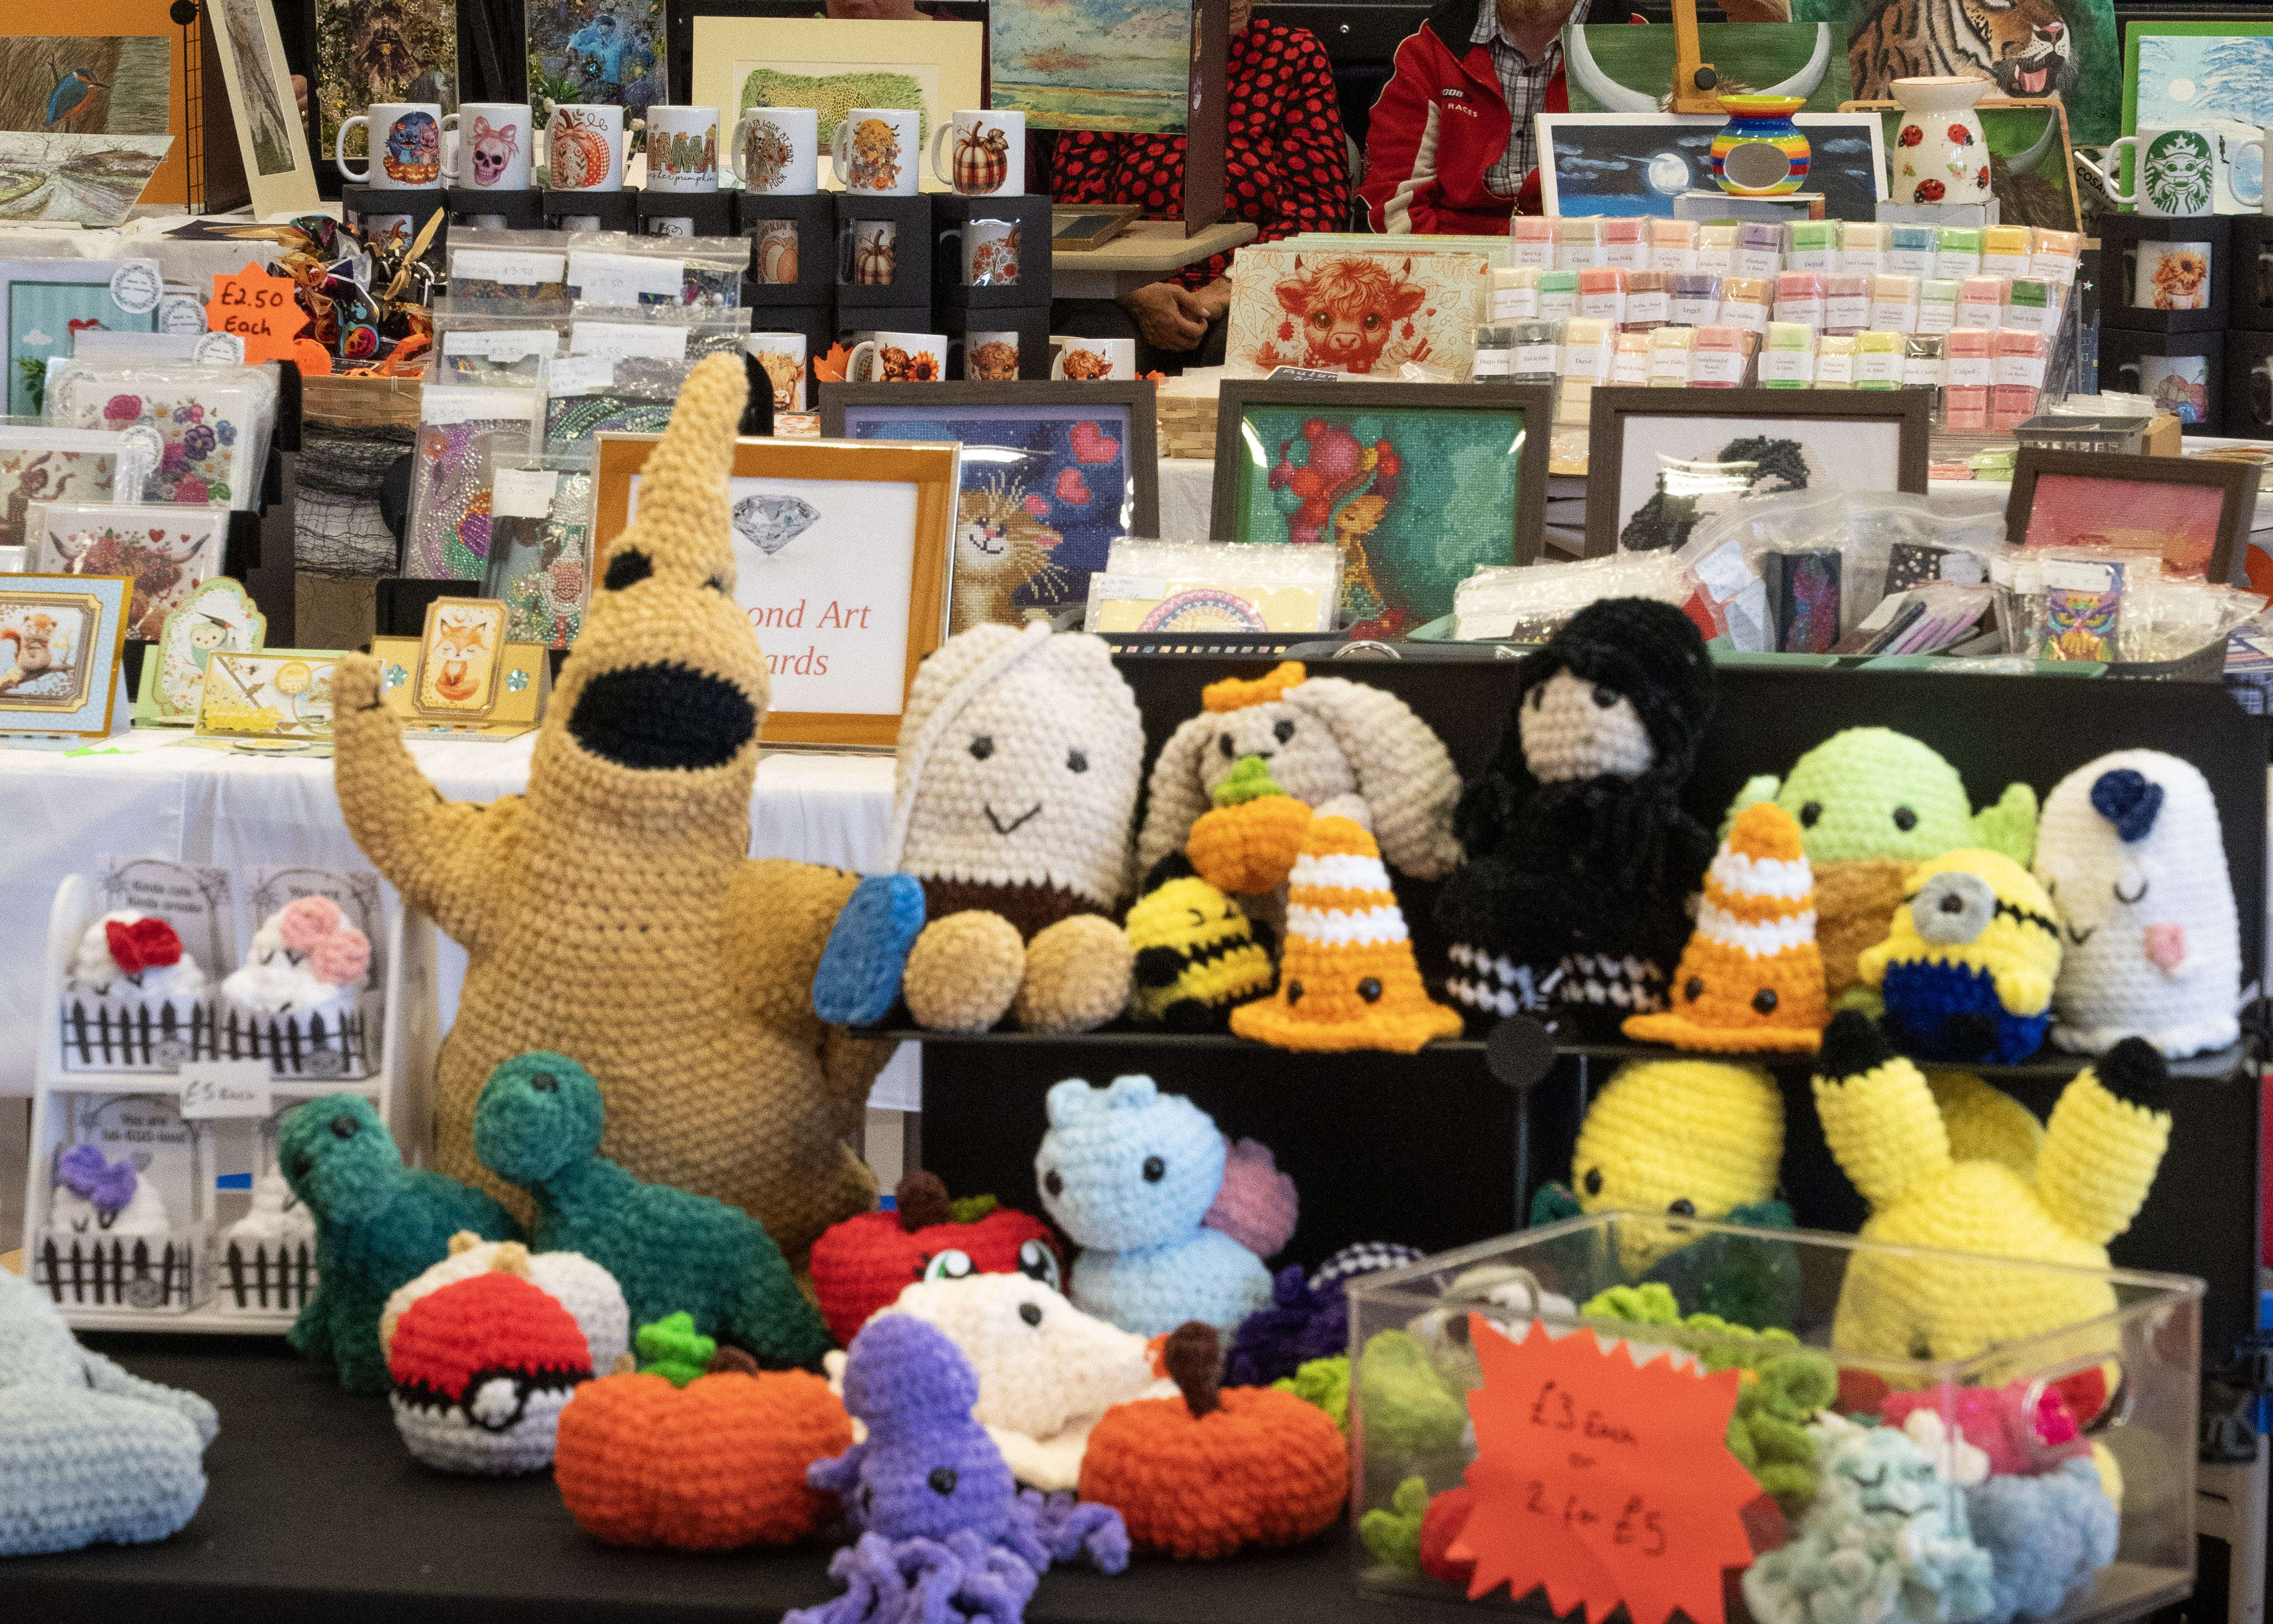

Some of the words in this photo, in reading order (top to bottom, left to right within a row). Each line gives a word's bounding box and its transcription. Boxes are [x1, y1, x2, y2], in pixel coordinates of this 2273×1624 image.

[1448, 102, 1478, 117] RACES
[762, 120, 780, 133] LOOK
[769, 173, 787, 189] FUCK
[221, 281, 283, 308] £2.50
[1683, 307, 1701, 315] Angel
[225, 315, 271, 336] Each
[1283, 368, 1338, 379] Autum
[747, 598, 807, 629] ond
[815, 600, 872, 629] Art
[764, 645, 829, 676] ards
[1529, 1379, 1576, 1432] £3
[1612, 1493, 1667, 1557] £5
